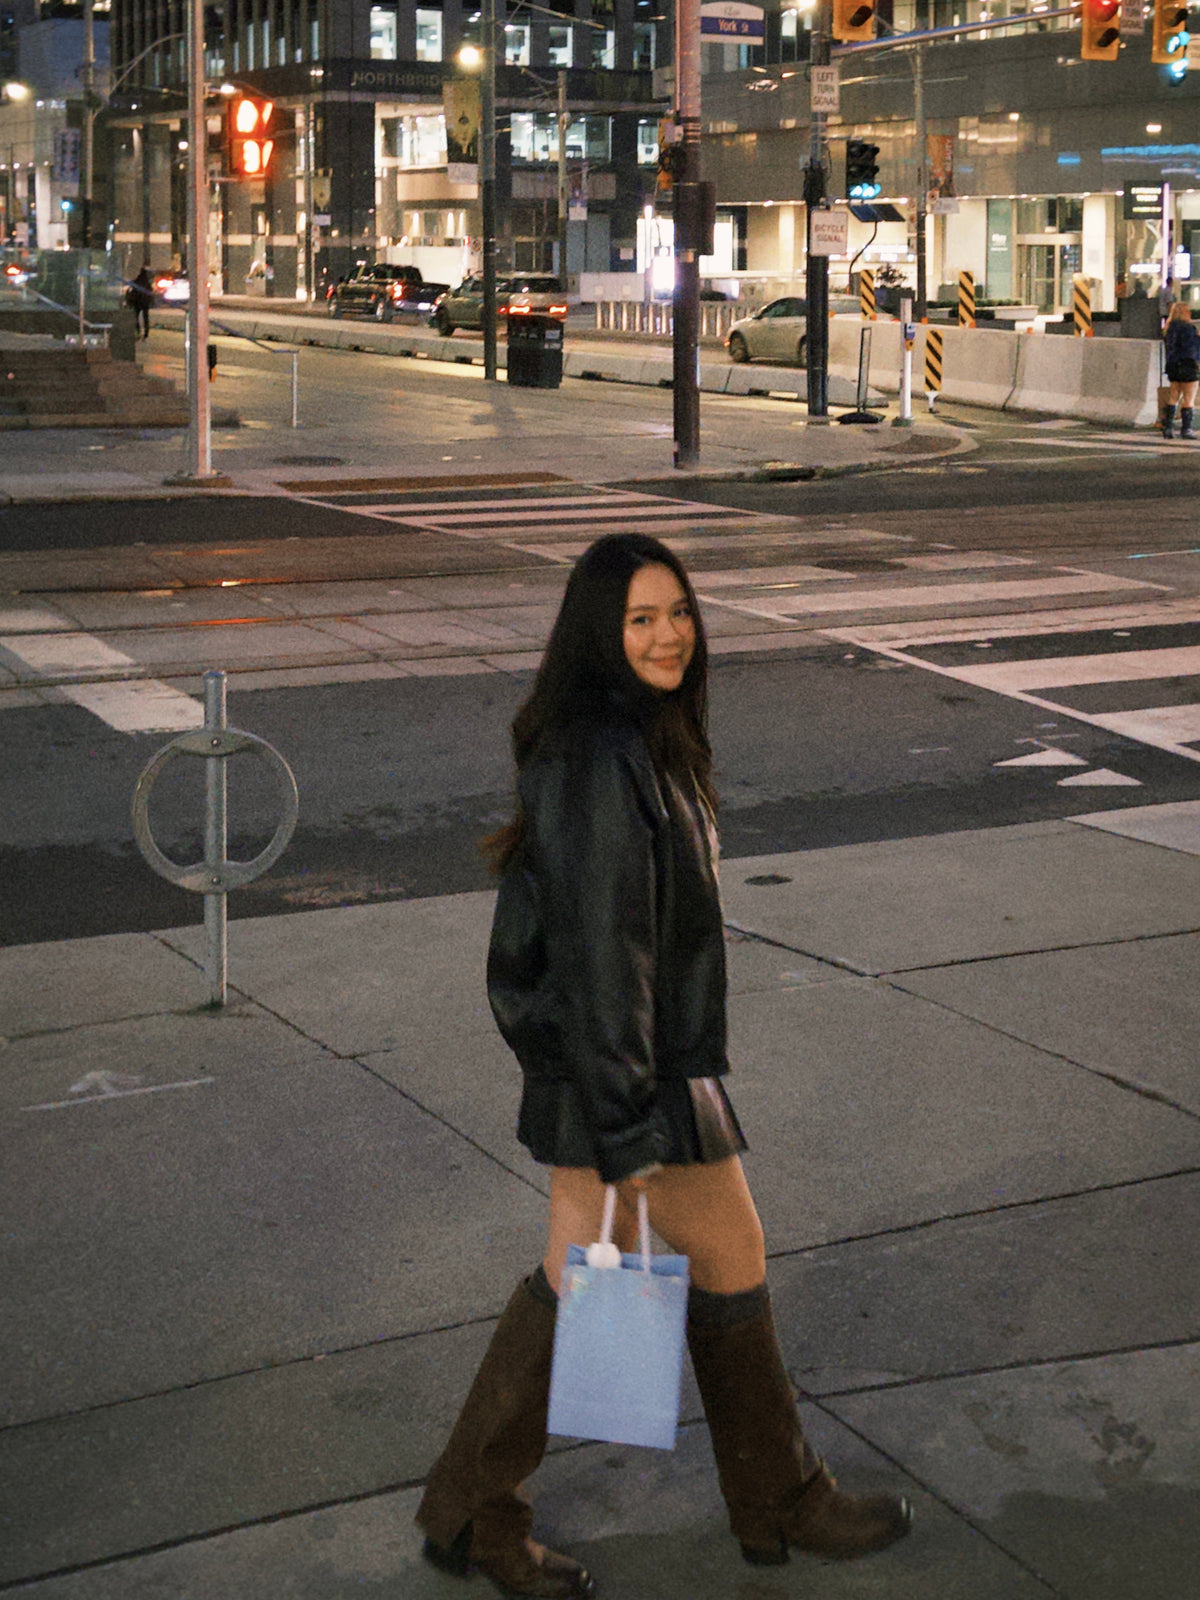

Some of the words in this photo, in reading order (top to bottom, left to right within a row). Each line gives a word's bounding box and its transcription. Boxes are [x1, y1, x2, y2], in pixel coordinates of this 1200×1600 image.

[718, 19, 738, 32] York
[816, 71, 834, 82] LEFT
[817, 83, 835, 94] TURN
[813, 96, 838, 105] SIGNAL
[815, 223, 844, 233] BICYCLE
[816, 234, 842, 243] SIGNAL
